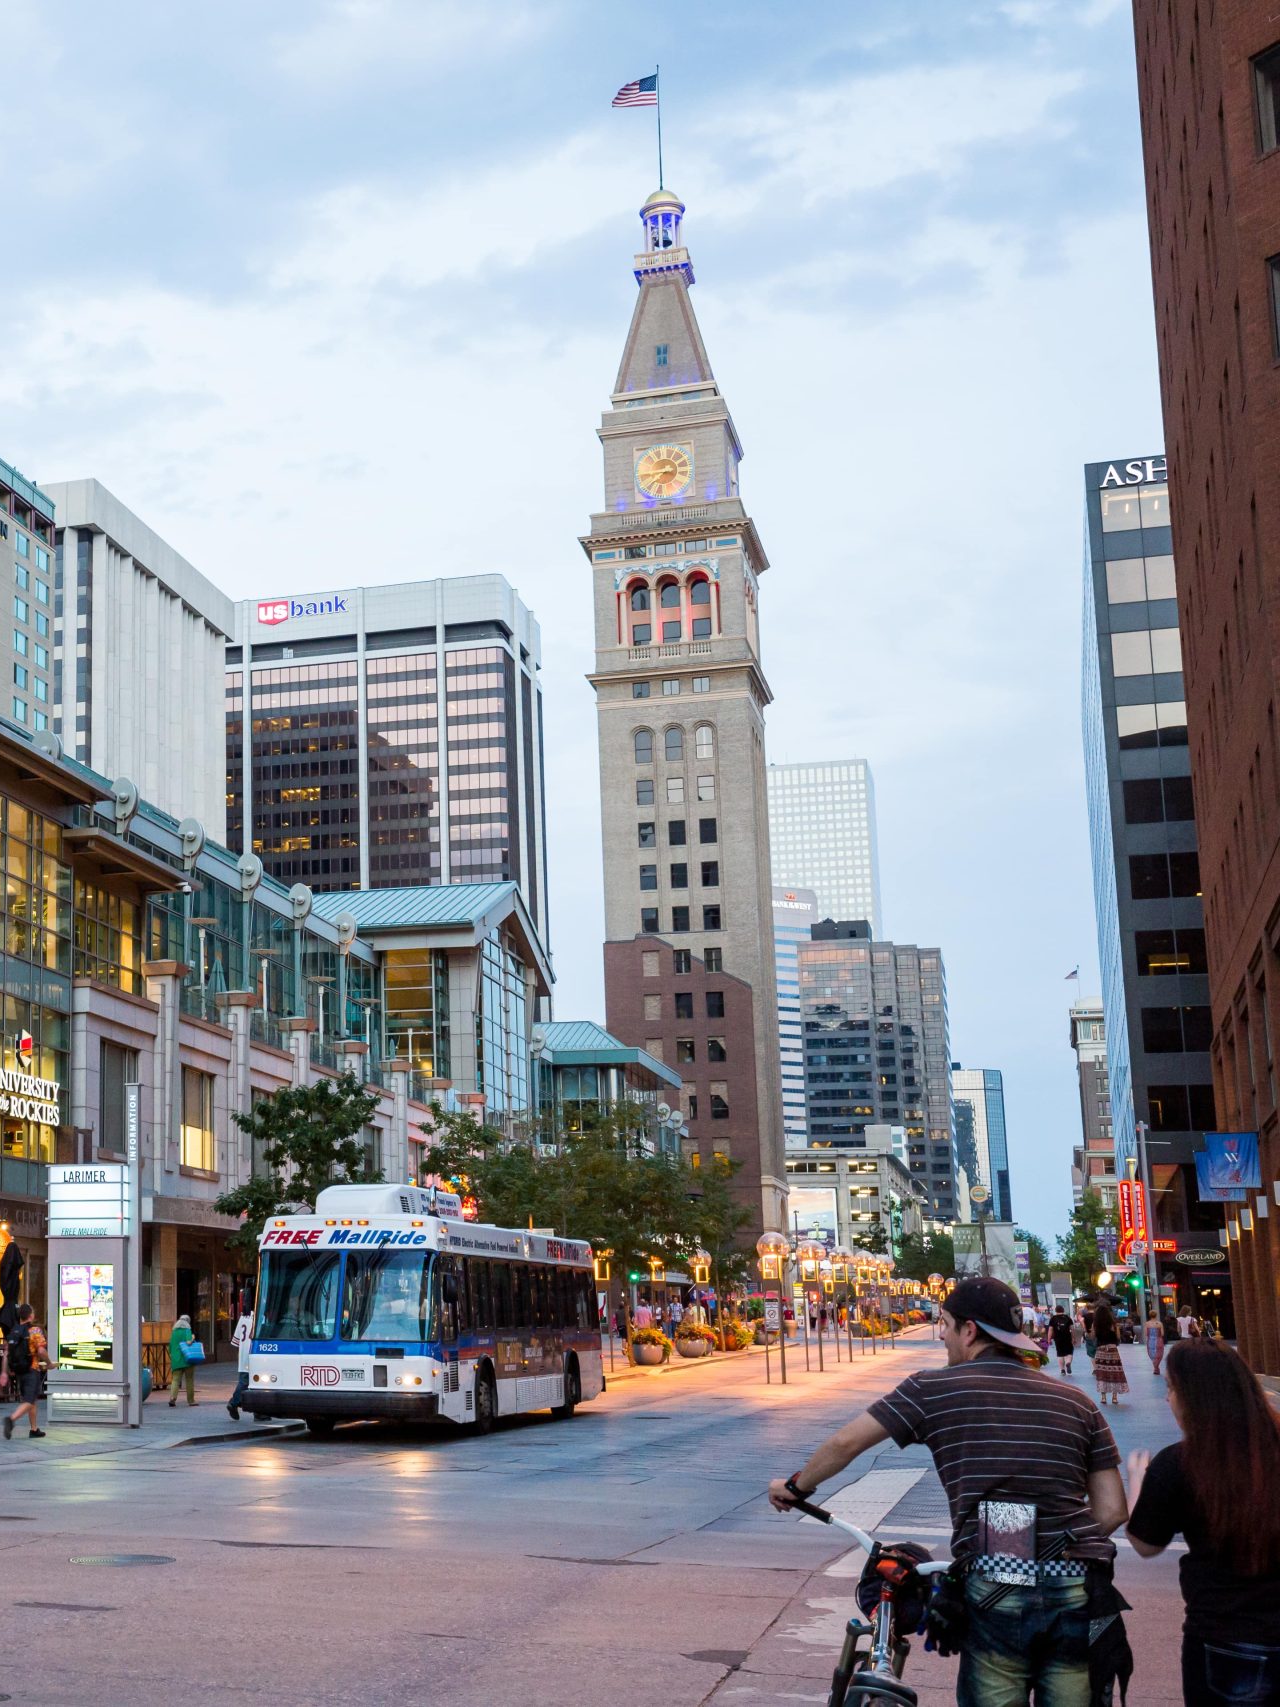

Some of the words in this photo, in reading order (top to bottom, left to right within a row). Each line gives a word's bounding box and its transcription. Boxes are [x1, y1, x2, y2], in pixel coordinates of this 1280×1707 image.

[0, 1093, 10, 1112] the
[9, 1096, 60, 1126] ROCKIES
[129, 1094, 137, 1161] INFORMATION
[63, 1170, 106, 1183] LARIMER
[61, 1227, 76, 1236] FREE
[77, 1227, 108, 1236] MALLRIDE
[263, 1230, 323, 1245] FREE
[328, 1229, 427, 1245] MallRide
[1178, 1253, 1222, 1261] OVERLAND
[241, 1324, 247, 1342] 3
[259, 1343, 278, 1352] 1623
[300, 1365, 340, 1386] RTD
